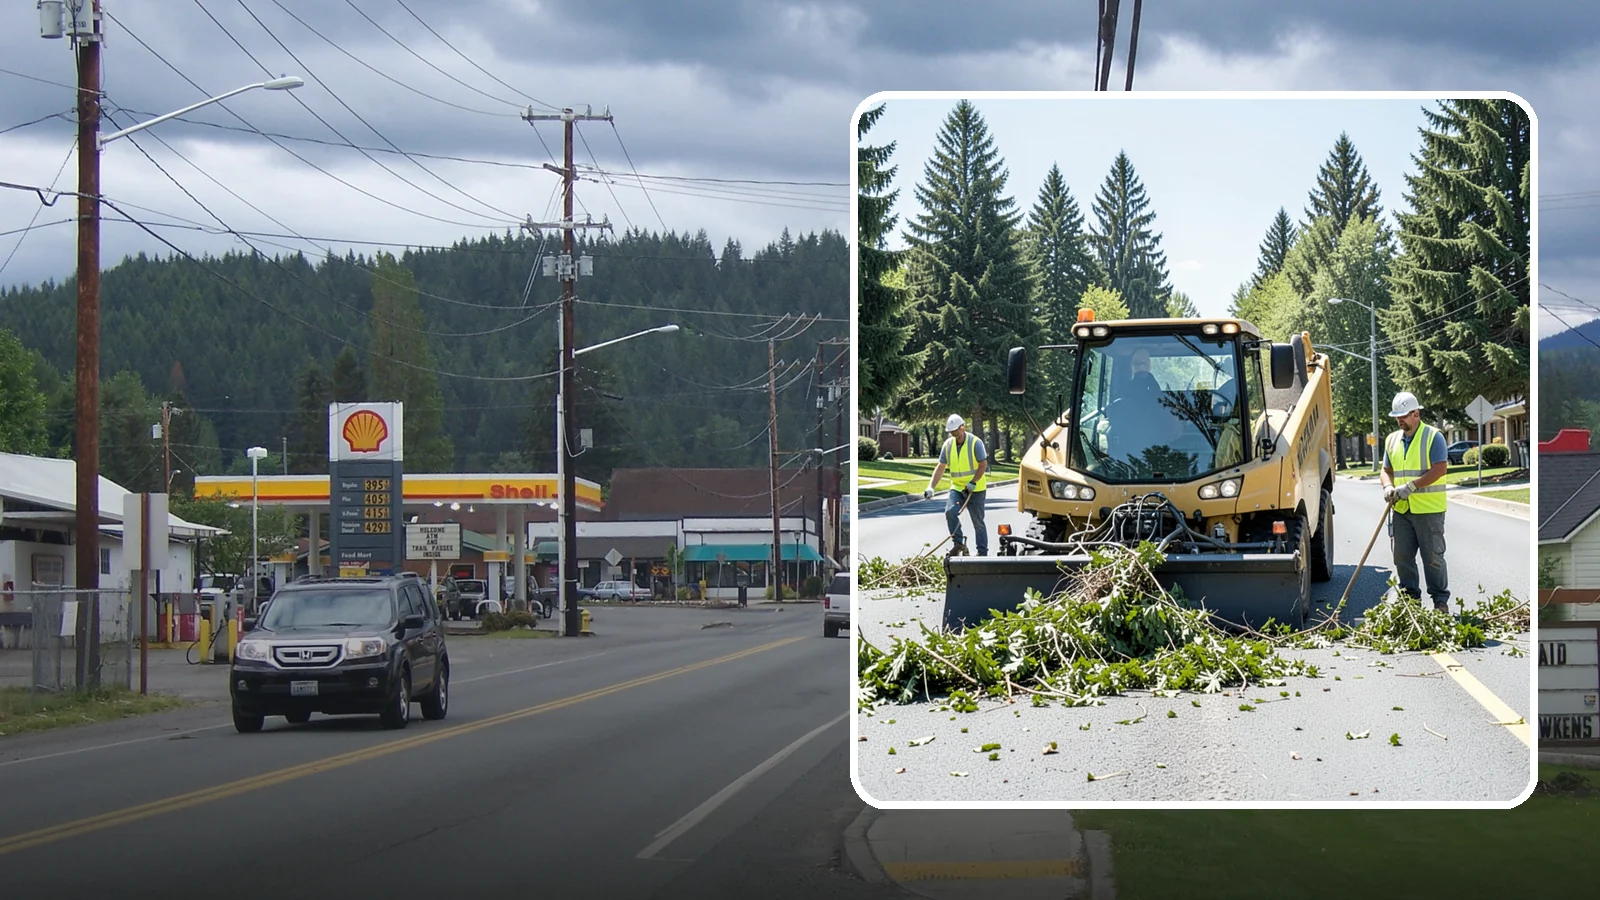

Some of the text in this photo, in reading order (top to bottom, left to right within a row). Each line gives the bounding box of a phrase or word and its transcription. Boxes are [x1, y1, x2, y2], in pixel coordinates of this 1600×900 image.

[365, 480, 384, 490] 395
[489, 484, 547, 499] Shell
[365, 494, 384, 504] 405
[365, 508, 384, 518] 415
[365, 522, 384, 532] 429
